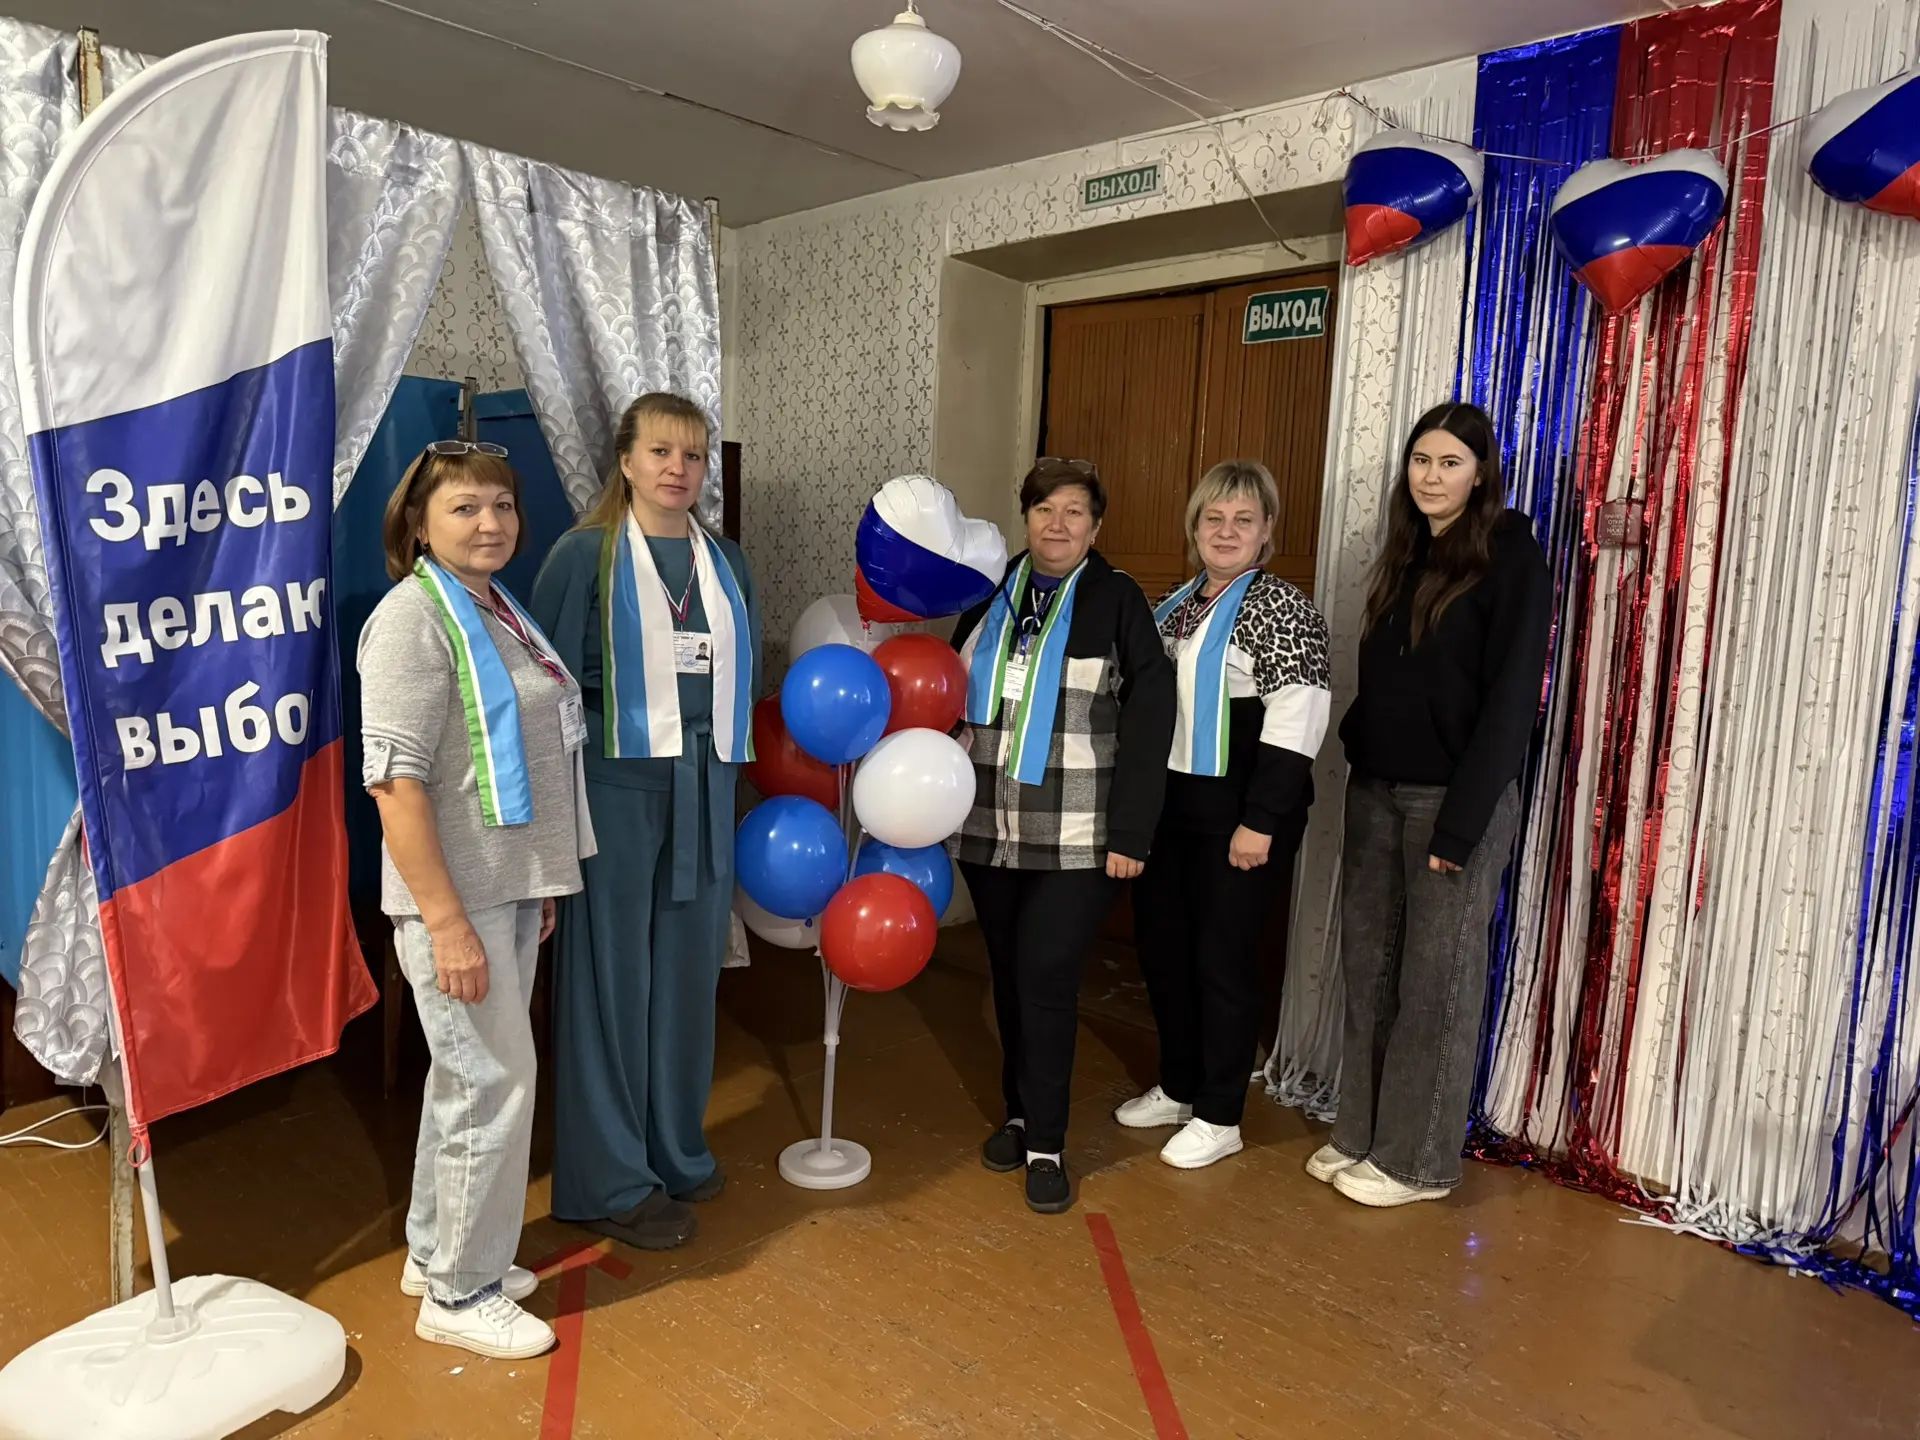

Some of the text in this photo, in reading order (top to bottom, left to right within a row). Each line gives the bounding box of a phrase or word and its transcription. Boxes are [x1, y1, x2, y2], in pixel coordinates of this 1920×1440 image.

[1089, 170, 1155, 202] ВЫХОД
[1248, 297, 1322, 332] ВЫХОД
[86, 468, 311, 551] Здесь
[115, 681, 314, 770] выбо
